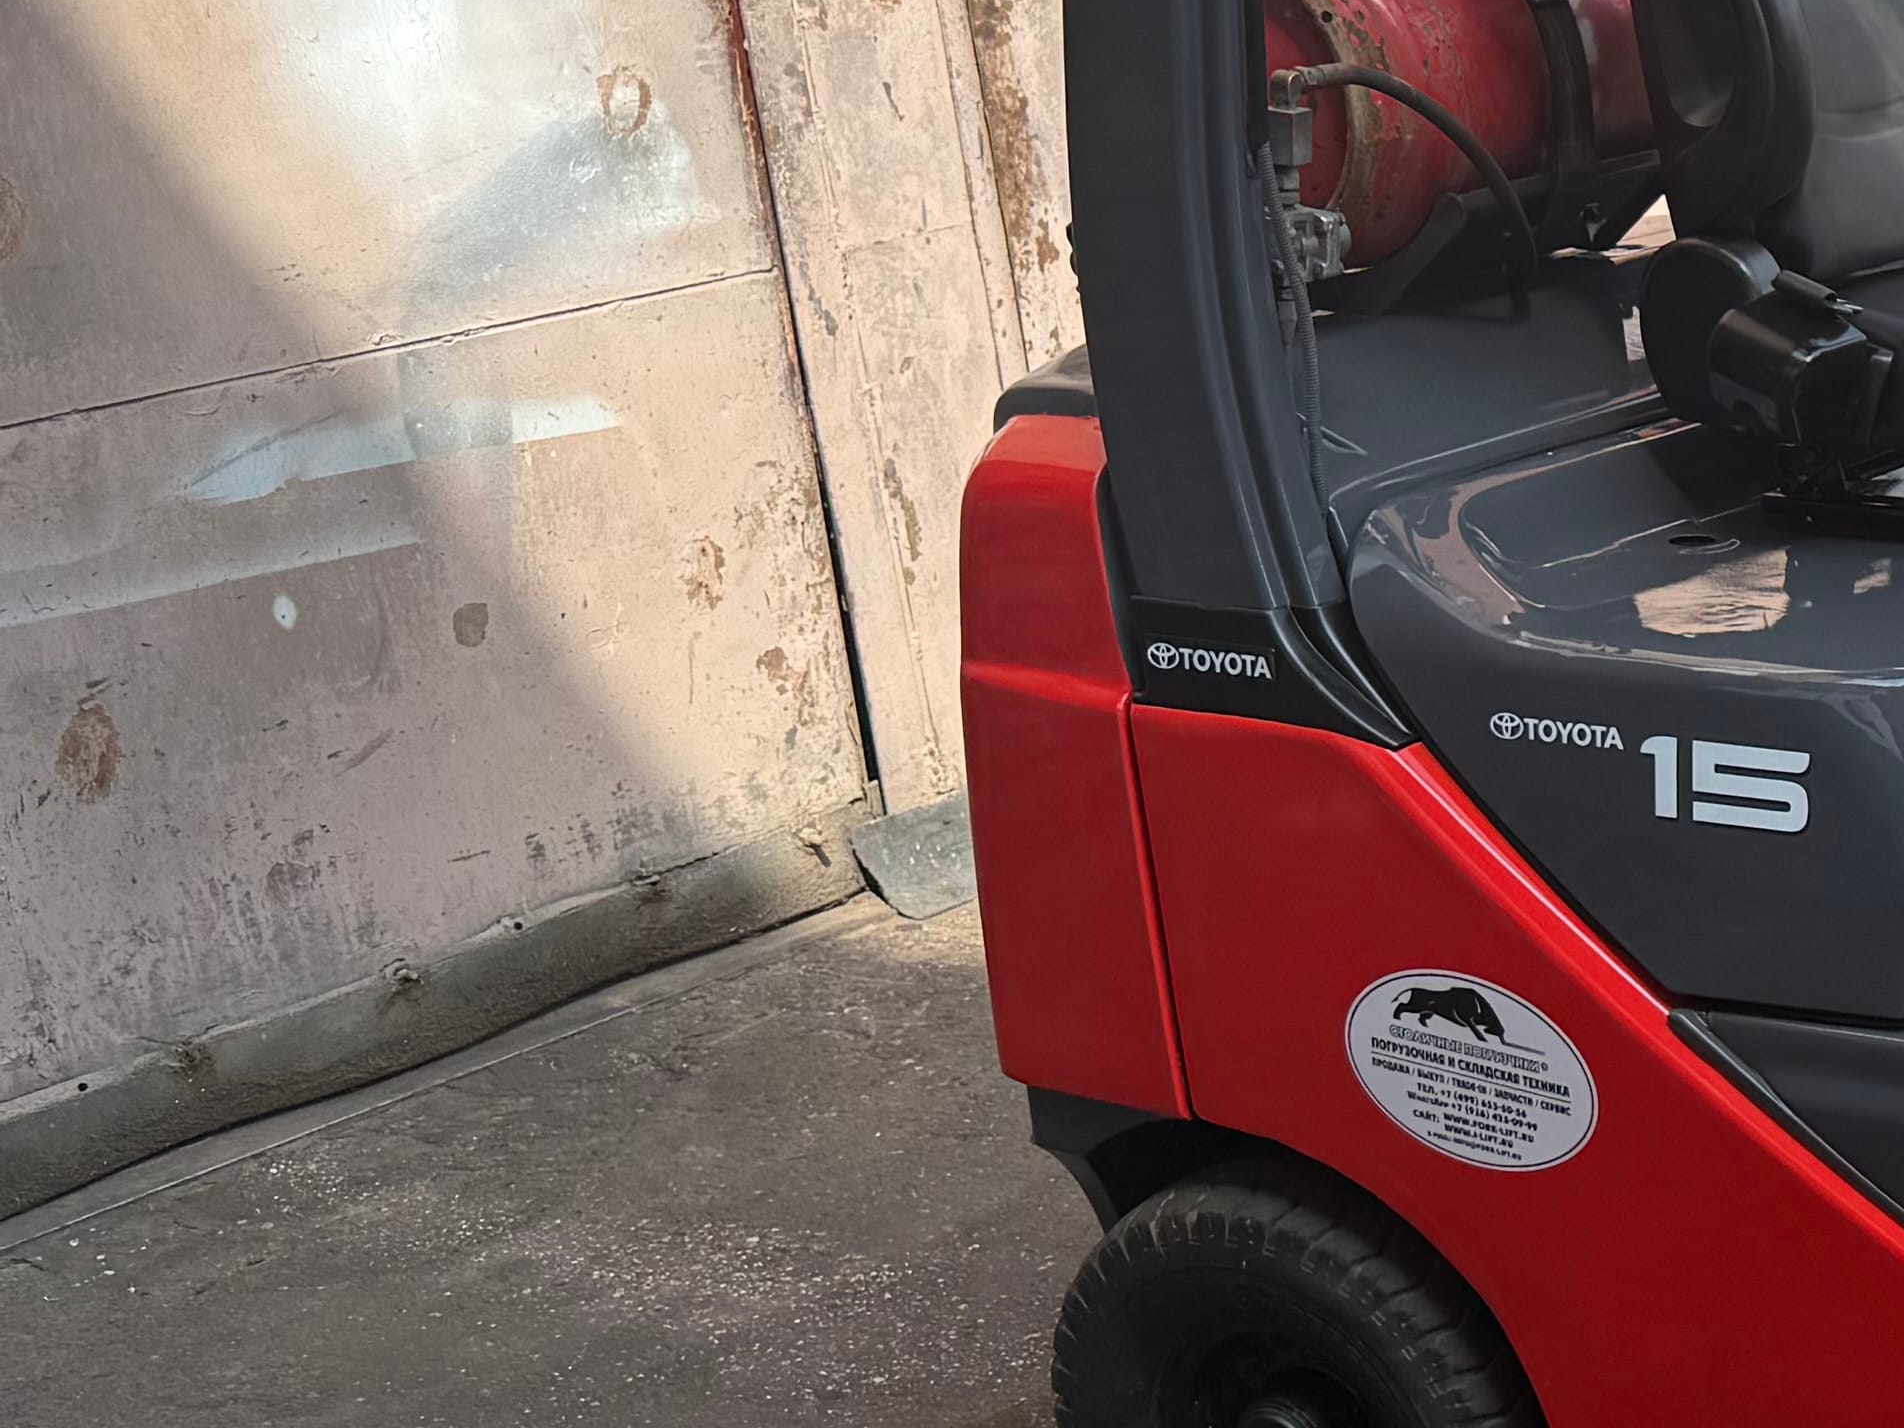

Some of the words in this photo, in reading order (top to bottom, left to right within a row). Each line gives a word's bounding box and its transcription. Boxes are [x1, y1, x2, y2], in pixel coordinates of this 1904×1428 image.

[1179, 647, 1272, 680] TOYOTA
[1524, 717, 1624, 751] TOYOTA
[1640, 735, 1811, 833] 15
[1371, 1036, 1446, 1066] ПОГРУЗОЧНАЯ
[1458, 1058, 1521, 1086] СКЛАДСКАЯ
[1522, 1074, 1570, 1098] ТЕХНИКА
